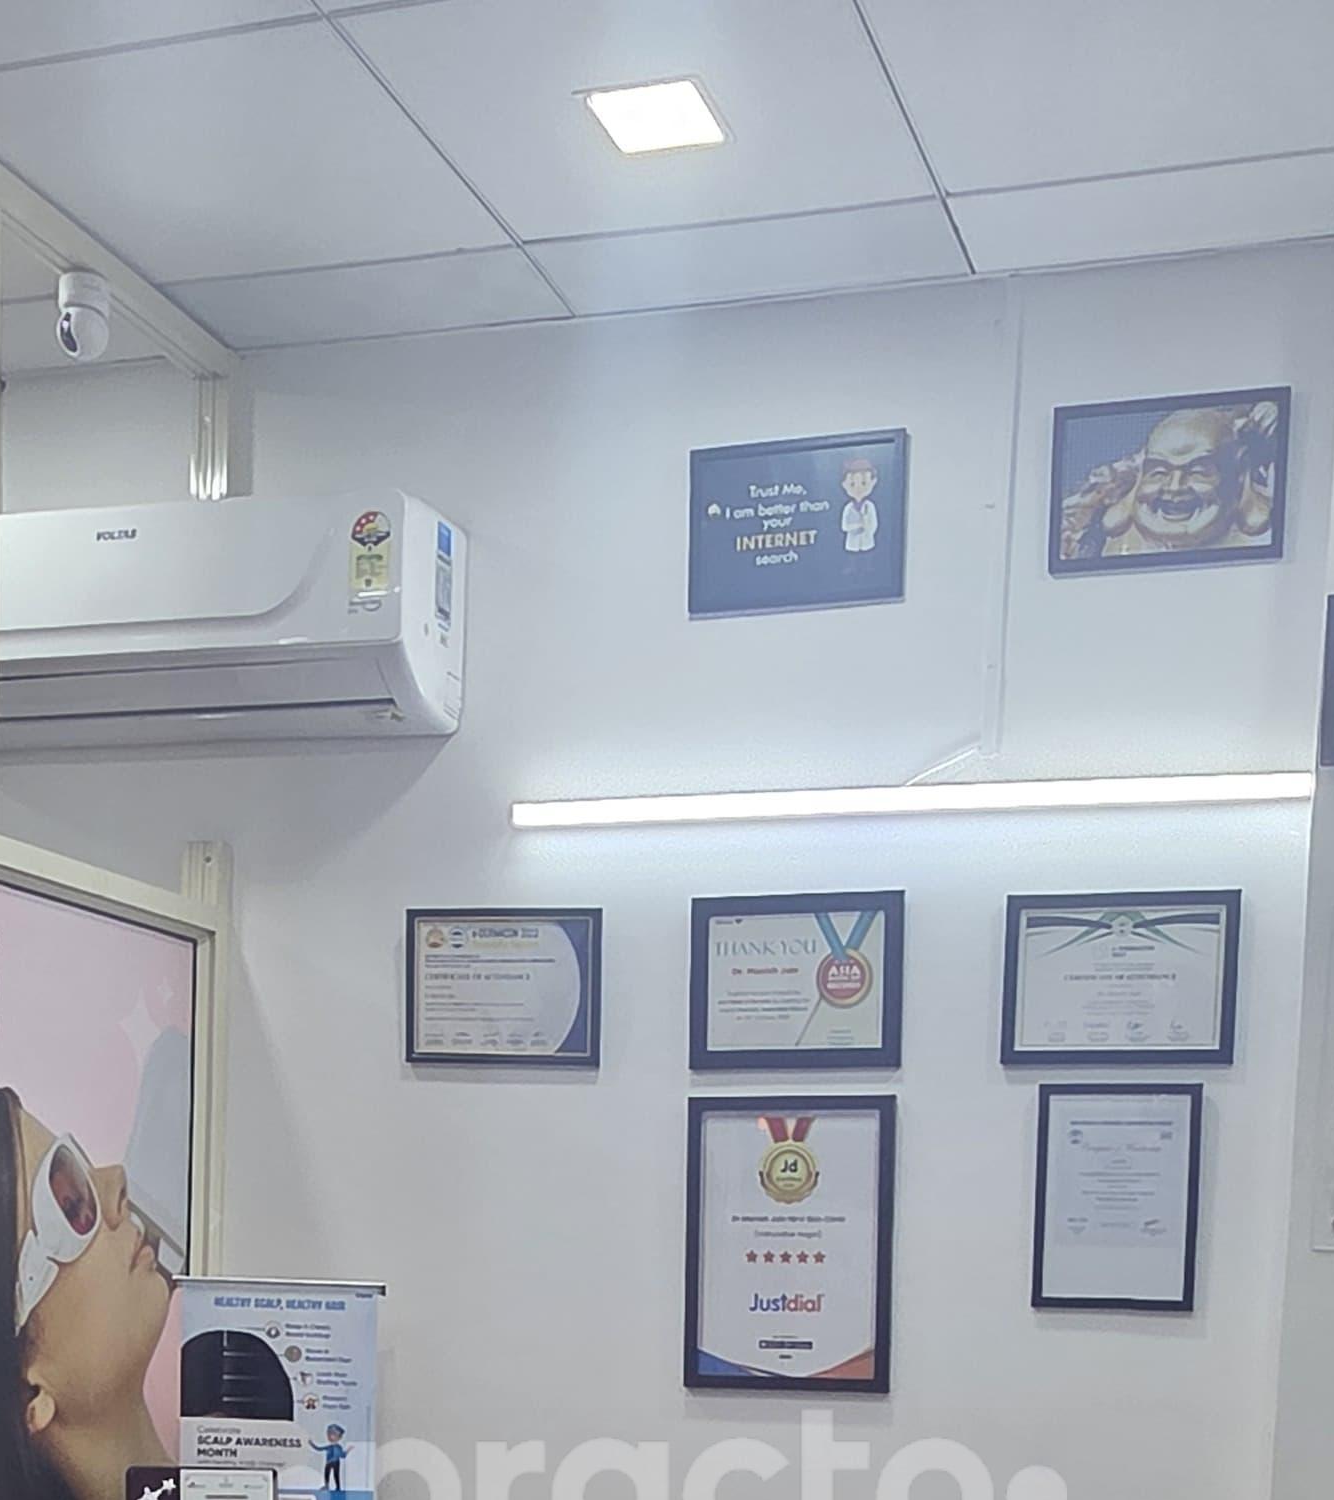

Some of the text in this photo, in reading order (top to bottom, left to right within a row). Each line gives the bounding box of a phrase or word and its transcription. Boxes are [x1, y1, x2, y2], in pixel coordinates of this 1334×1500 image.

[749, 485, 779, 498] Trust
[733, 508, 755, 519] am
[758, 503, 797, 517] better
[799, 501, 830, 513] than
[763, 517, 792, 531] your
[736, 530, 818, 551] INTERNET
[755, 550, 798, 566] search
[717, 938, 817, 956] THANK YOU
[780, 1159, 798, 1173] Jd
[749, 1292, 823, 1312] Justdial
[197, 1435, 303, 1449] SCALP AWARENESS
[197, 1447, 238, 1458] MONTH
